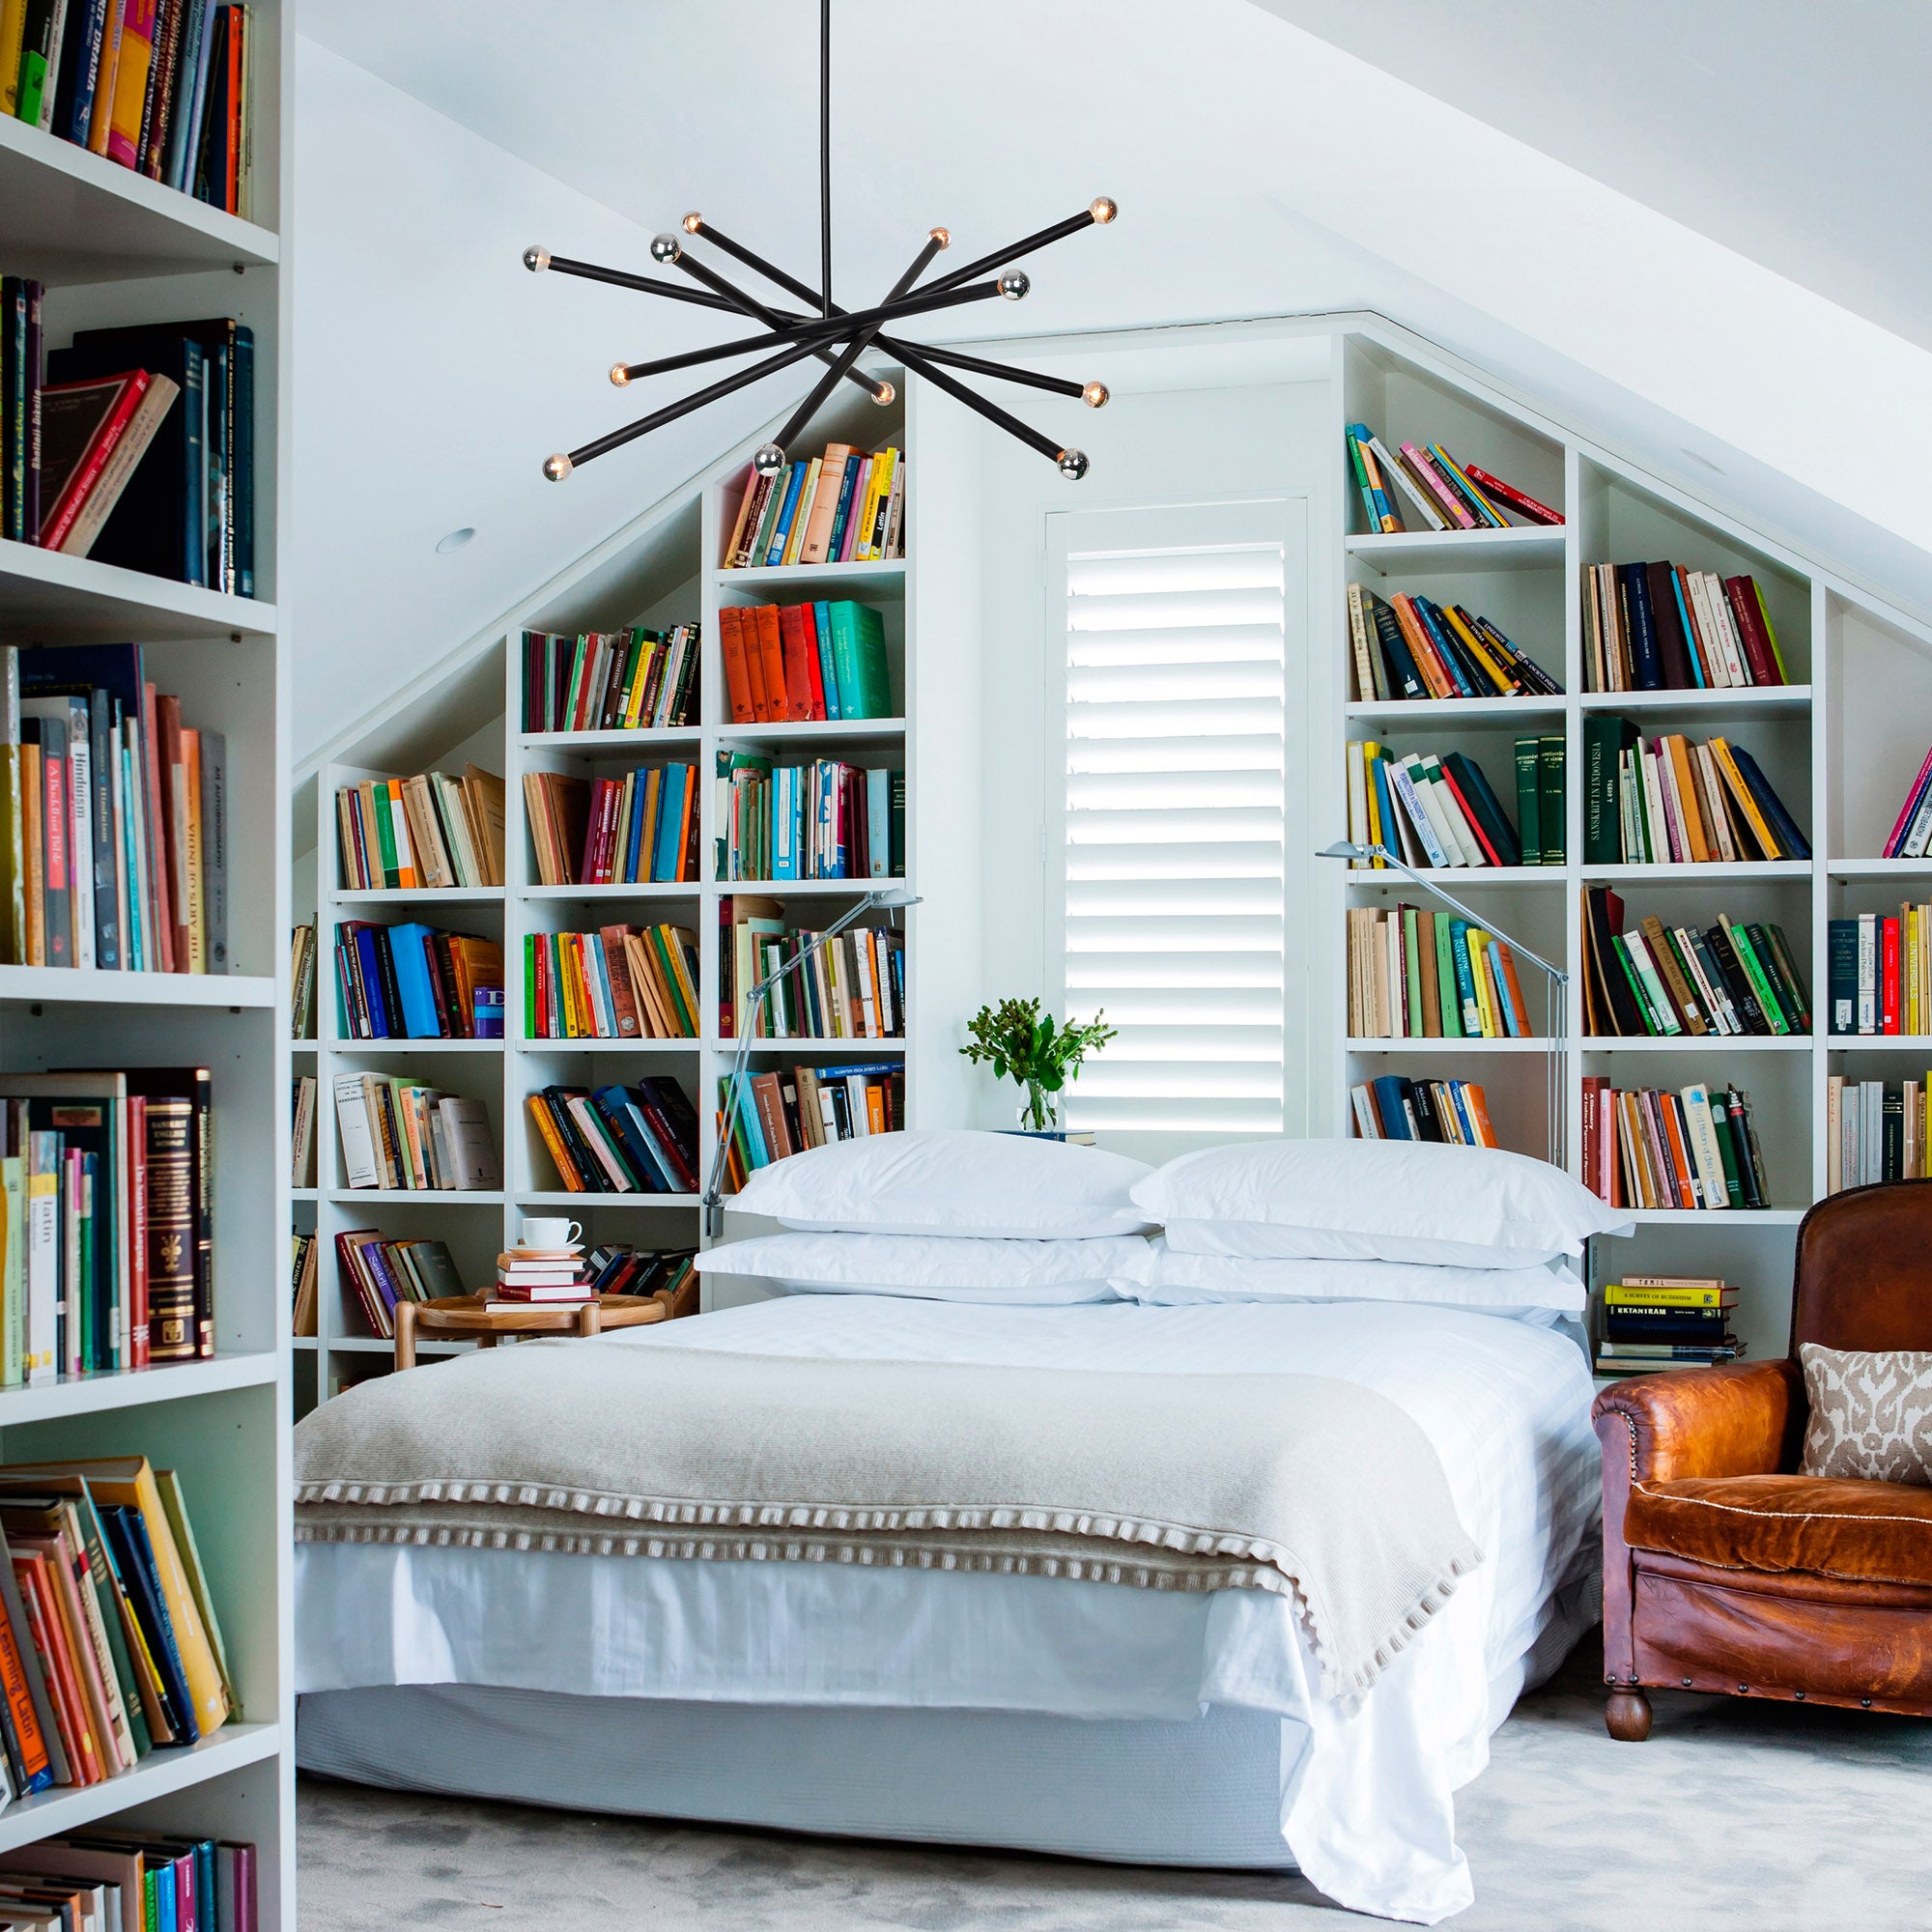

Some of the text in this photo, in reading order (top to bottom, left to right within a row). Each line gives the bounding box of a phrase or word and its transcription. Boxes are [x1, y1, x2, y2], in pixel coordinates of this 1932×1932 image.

[85, 28, 104, 91] DRAMA
[156, 25, 169, 87] LITERATURE
[138, 19, 162, 160] THOUGHT IN ANCIENT INDIA
[1406, 446, 1438, 484] Reincarnation
[875, 510, 887, 530] Latin
[1469, 624, 1485, 642] SYNTAX
[1483, 622, 1506, 644] LINGUISTIC
[1527, 663, 1546, 680] ANCIENT
[1543, 677, 1556, 690] INDIA
[611, 649, 624, 689] BUDDHISM
[73, 753, 89, 817] Hinduism
[1590, 741, 1601, 839] SANSKRIT IN INDONESIA
[49, 765, 61, 865] A Buddhist Bible
[98, 786, 110, 842] Hinduism
[214, 784, 223, 870] AUTOBIOGRAPHY
[1670, 824, 1681, 859] Makaranda
[188, 872, 196, 888] OF
[877, 940, 890, 1010] ENLIGHTENED BEINGS
[1453, 939, 1465, 990] INDIAN HISTORY
[1459, 938, 1468, 972] SITUATING
[1909, 941, 1918, 998] UNIVERSALS
[1695, 1122, 1711, 1146] History
[135, 1165, 144, 1182] The
[41, 1201, 54, 1242] latin
[134, 1226, 145, 1271] Language
[292, 1259, 303, 1284] SYNTAX
[367, 1254, 388, 1287] Sanskrit
[0, 1619, 28, 1696] Learning
[14, 1694, 39, 1740] Latin
